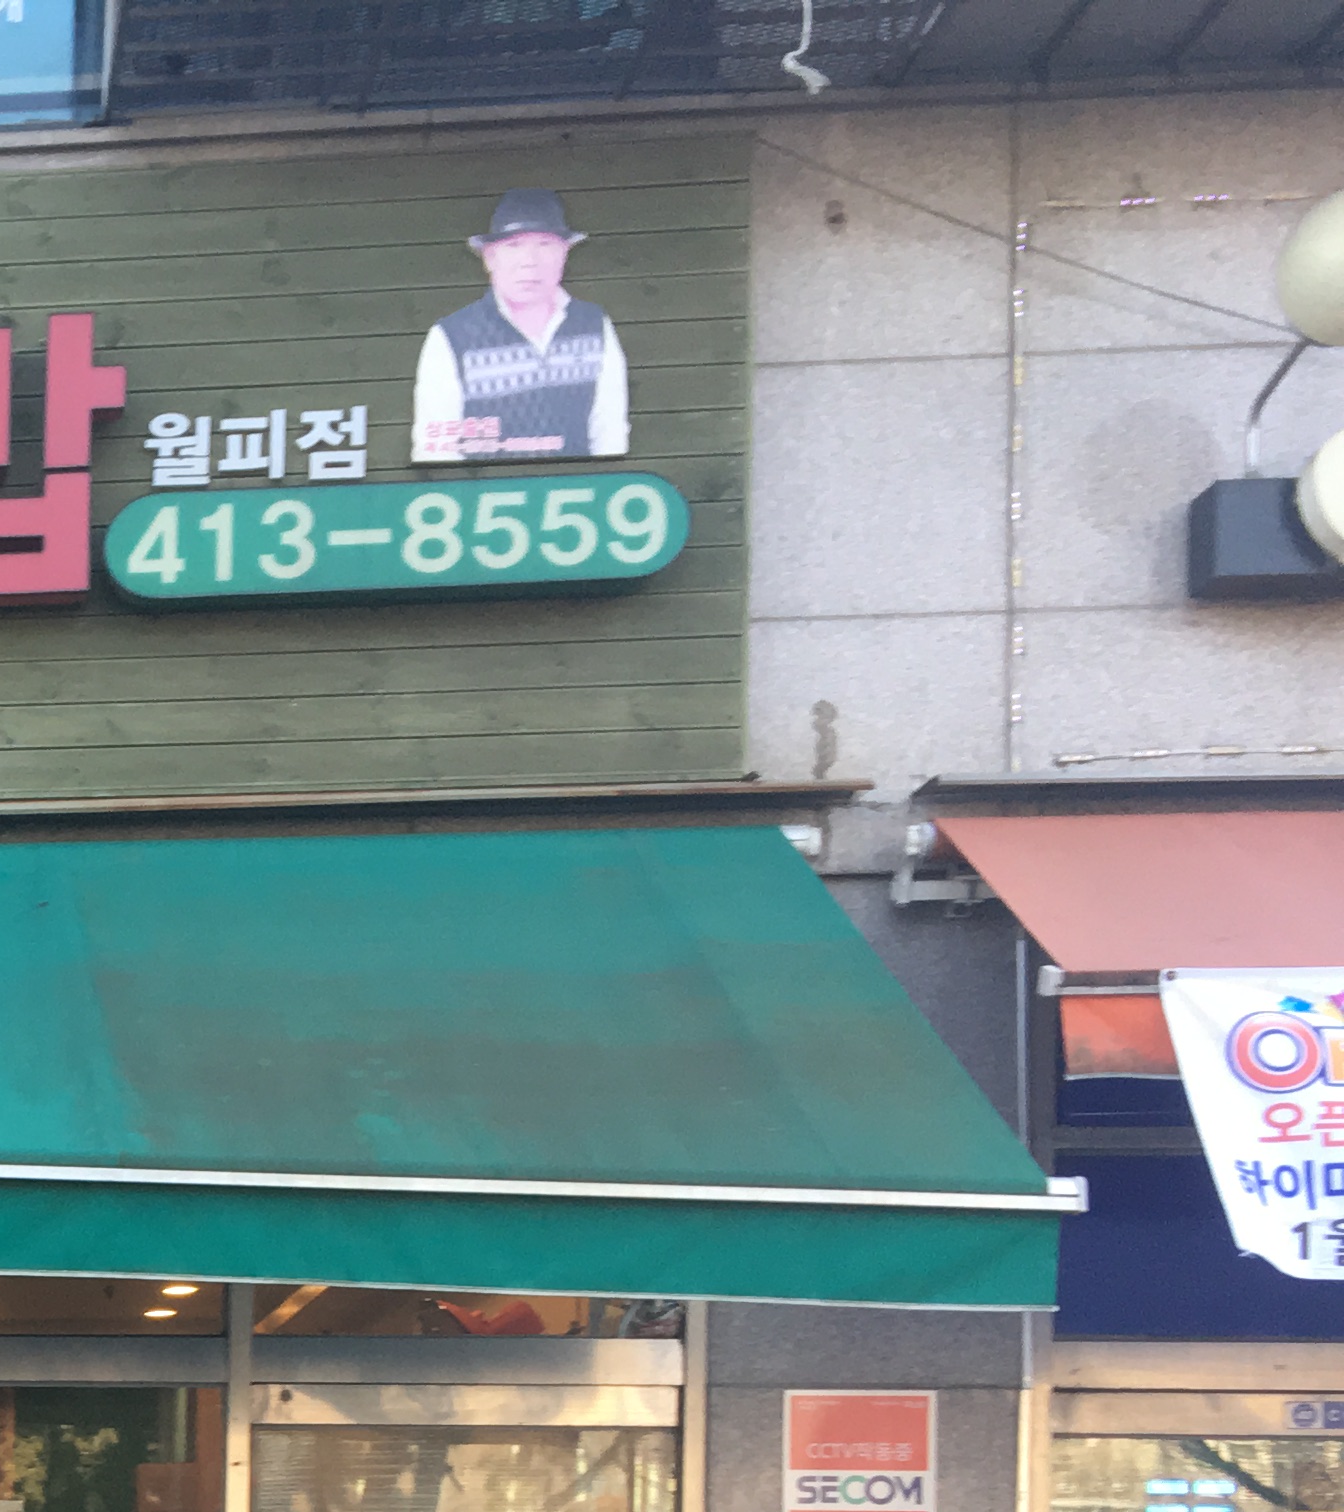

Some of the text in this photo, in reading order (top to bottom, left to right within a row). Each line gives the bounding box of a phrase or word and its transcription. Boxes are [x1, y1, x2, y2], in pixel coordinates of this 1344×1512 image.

[143, 405, 368, 488] 월피점
[126, 482, 669, 585] 413-8559
[796, 1474, 924, 1506] SECOM
